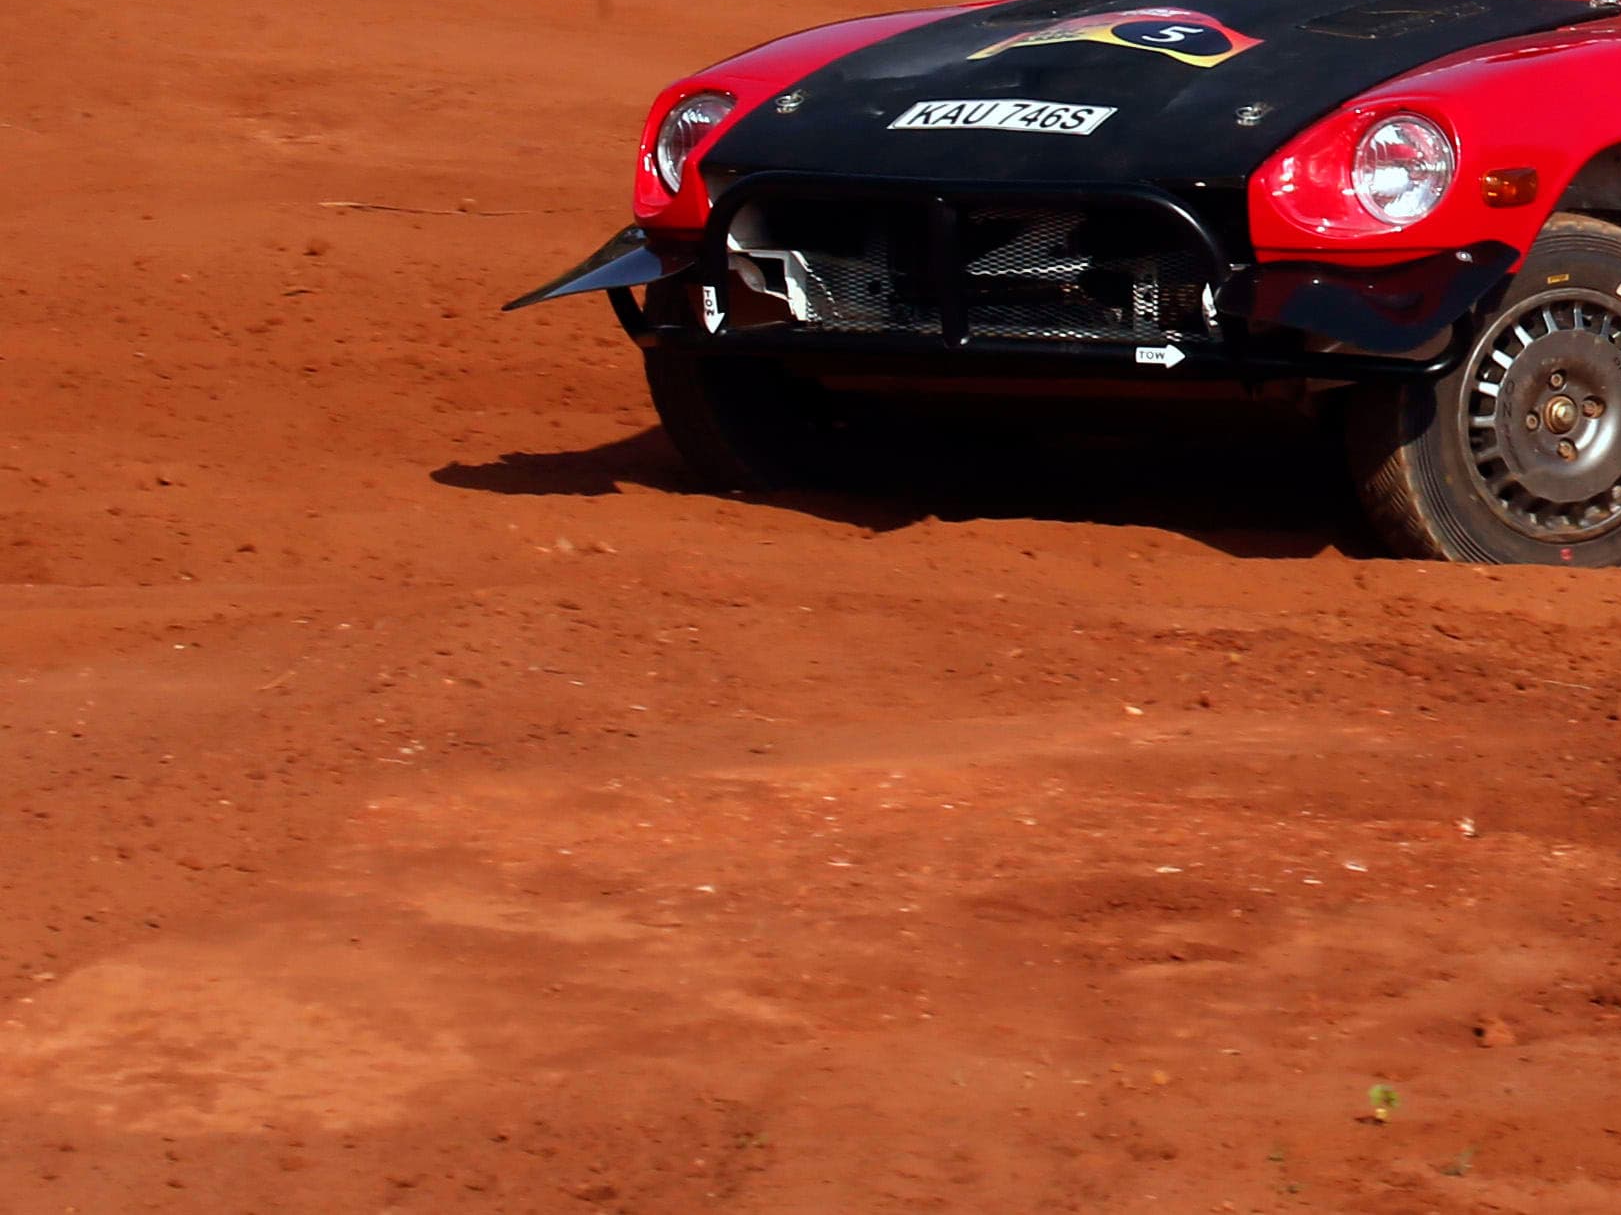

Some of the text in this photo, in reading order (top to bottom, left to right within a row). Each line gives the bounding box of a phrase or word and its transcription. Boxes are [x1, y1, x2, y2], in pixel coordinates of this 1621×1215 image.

[1142, 25, 1204, 44] 5
[907, 103, 1094, 130] KAU 746S
[703, 289, 714, 316] TOW
[1139, 351, 1165, 360] TOW
